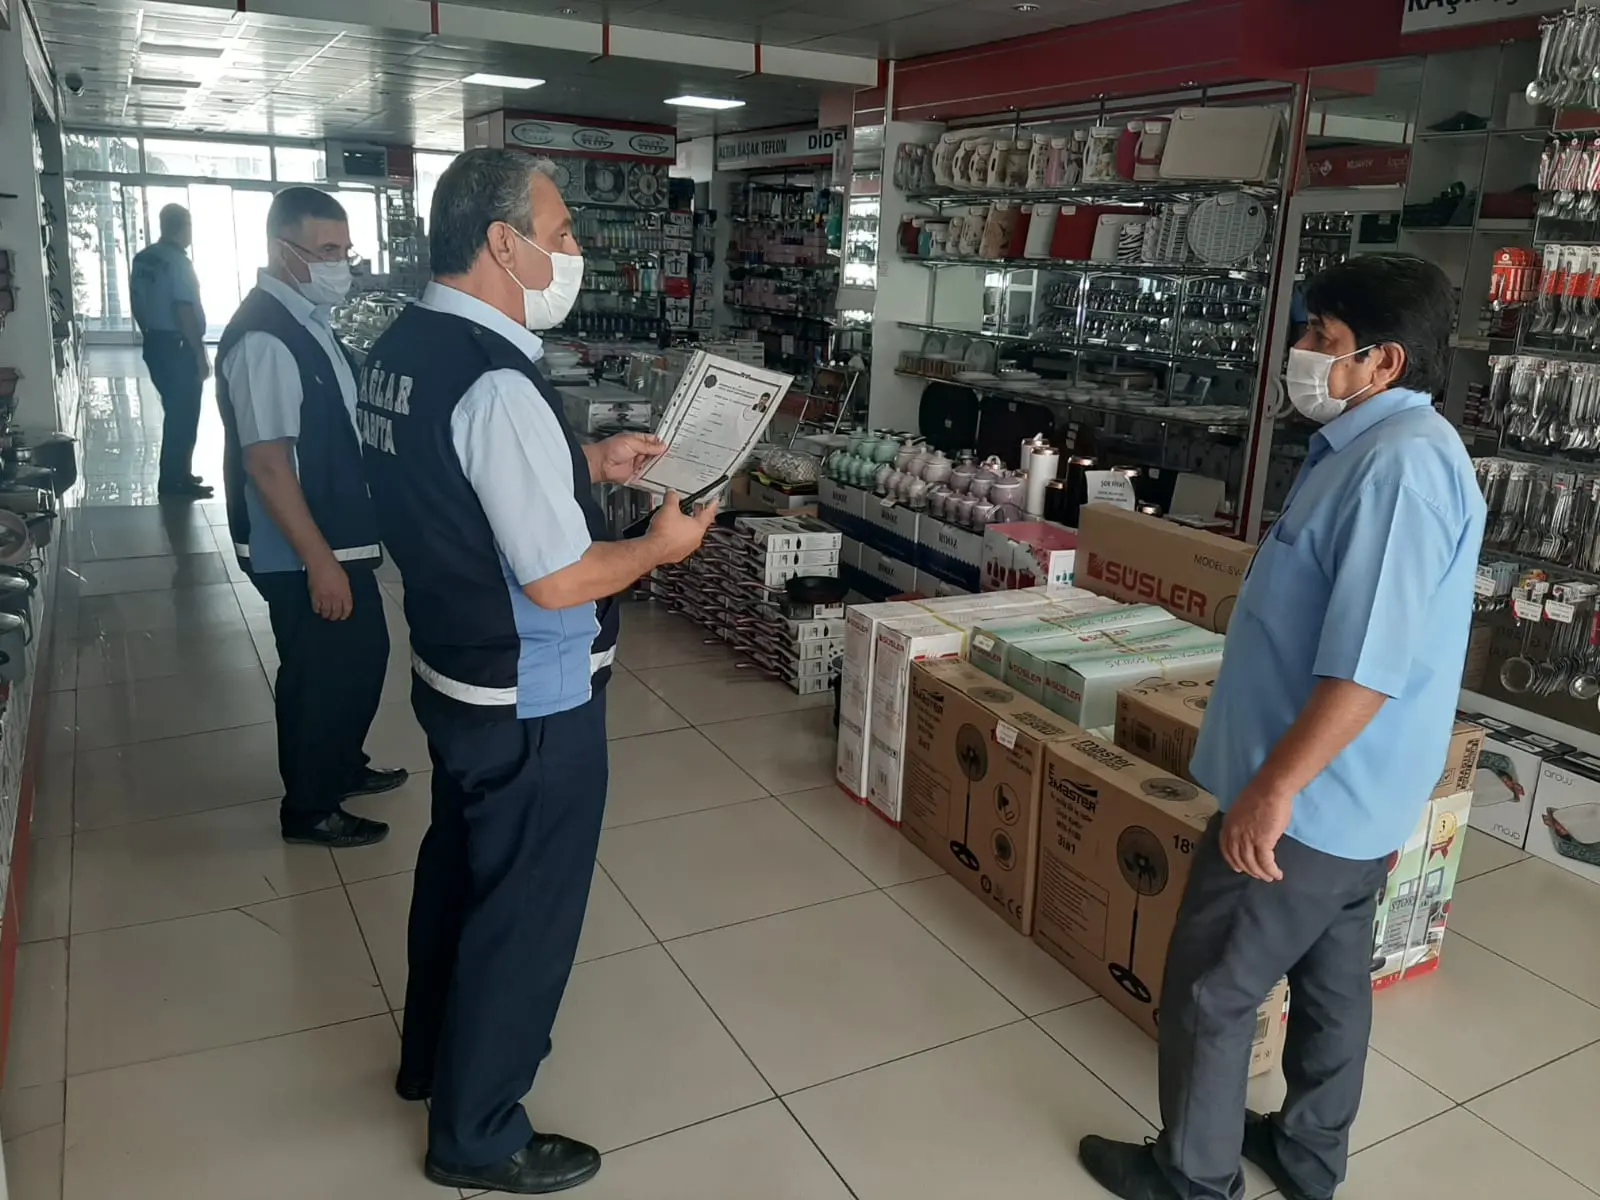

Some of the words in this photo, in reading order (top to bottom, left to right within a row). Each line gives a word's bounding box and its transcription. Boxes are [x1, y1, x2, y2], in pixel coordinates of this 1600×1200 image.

[761, 137, 787, 155] TEFLON
[360, 360, 413, 416] AĞLAR
[1105, 560, 1208, 618] SÜSLER
